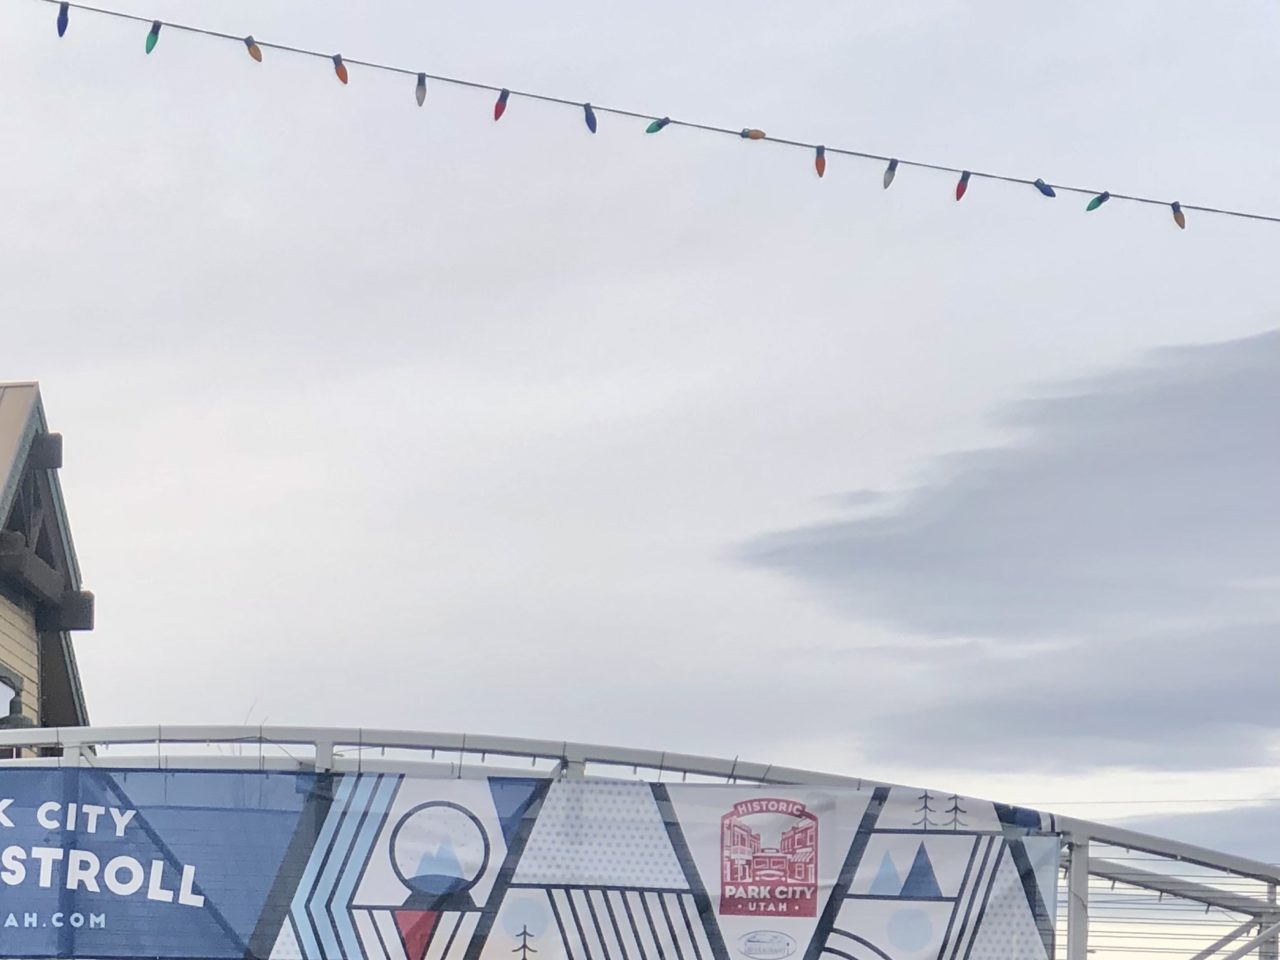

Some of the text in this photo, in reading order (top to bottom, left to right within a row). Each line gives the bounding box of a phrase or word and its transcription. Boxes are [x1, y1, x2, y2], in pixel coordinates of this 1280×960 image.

[736, 800, 804, 816] HISTORIC
[36, 801, 137, 837] CITY
[0, 844, 206, 908] STROLL
[724, 886, 815, 899] PARK CITY
[748, 902, 787, 912] UTAH
